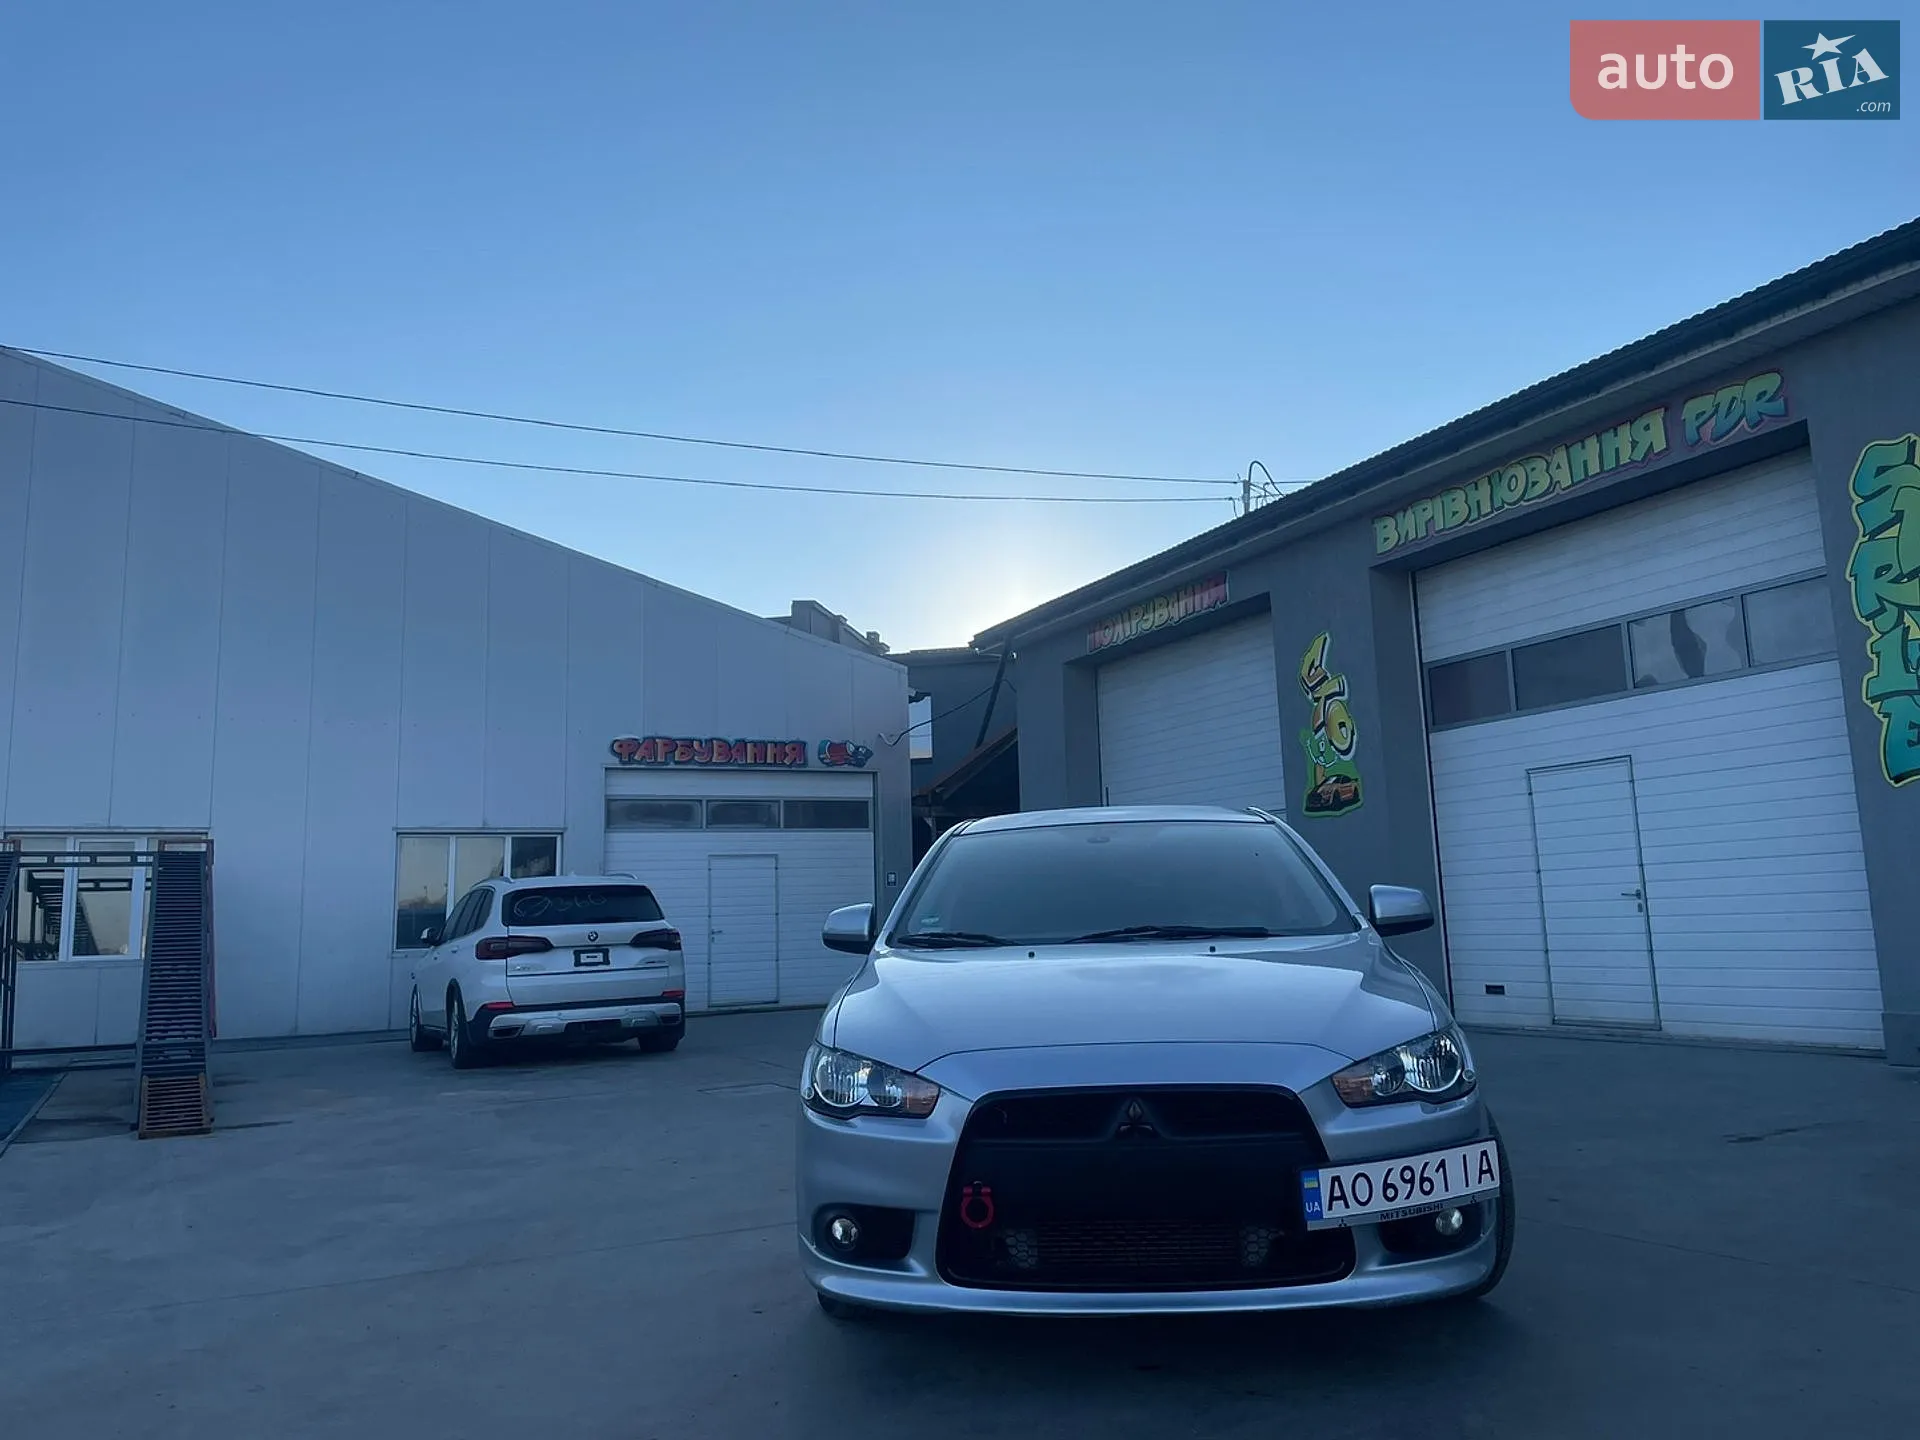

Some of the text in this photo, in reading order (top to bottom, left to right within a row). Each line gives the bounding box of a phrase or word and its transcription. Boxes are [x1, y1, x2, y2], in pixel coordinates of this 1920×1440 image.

[1374, 371, 1789, 554] ВИРІВНЮВАННЯ PDR
[611, 736, 807, 766] ФАРБУВАННЯ
[1327, 1149, 1495, 1212] AO 6961 IA
[1305, 1201, 1321, 1213] UA
[1379, 1203, 1444, 1221] MITSUBISHI
